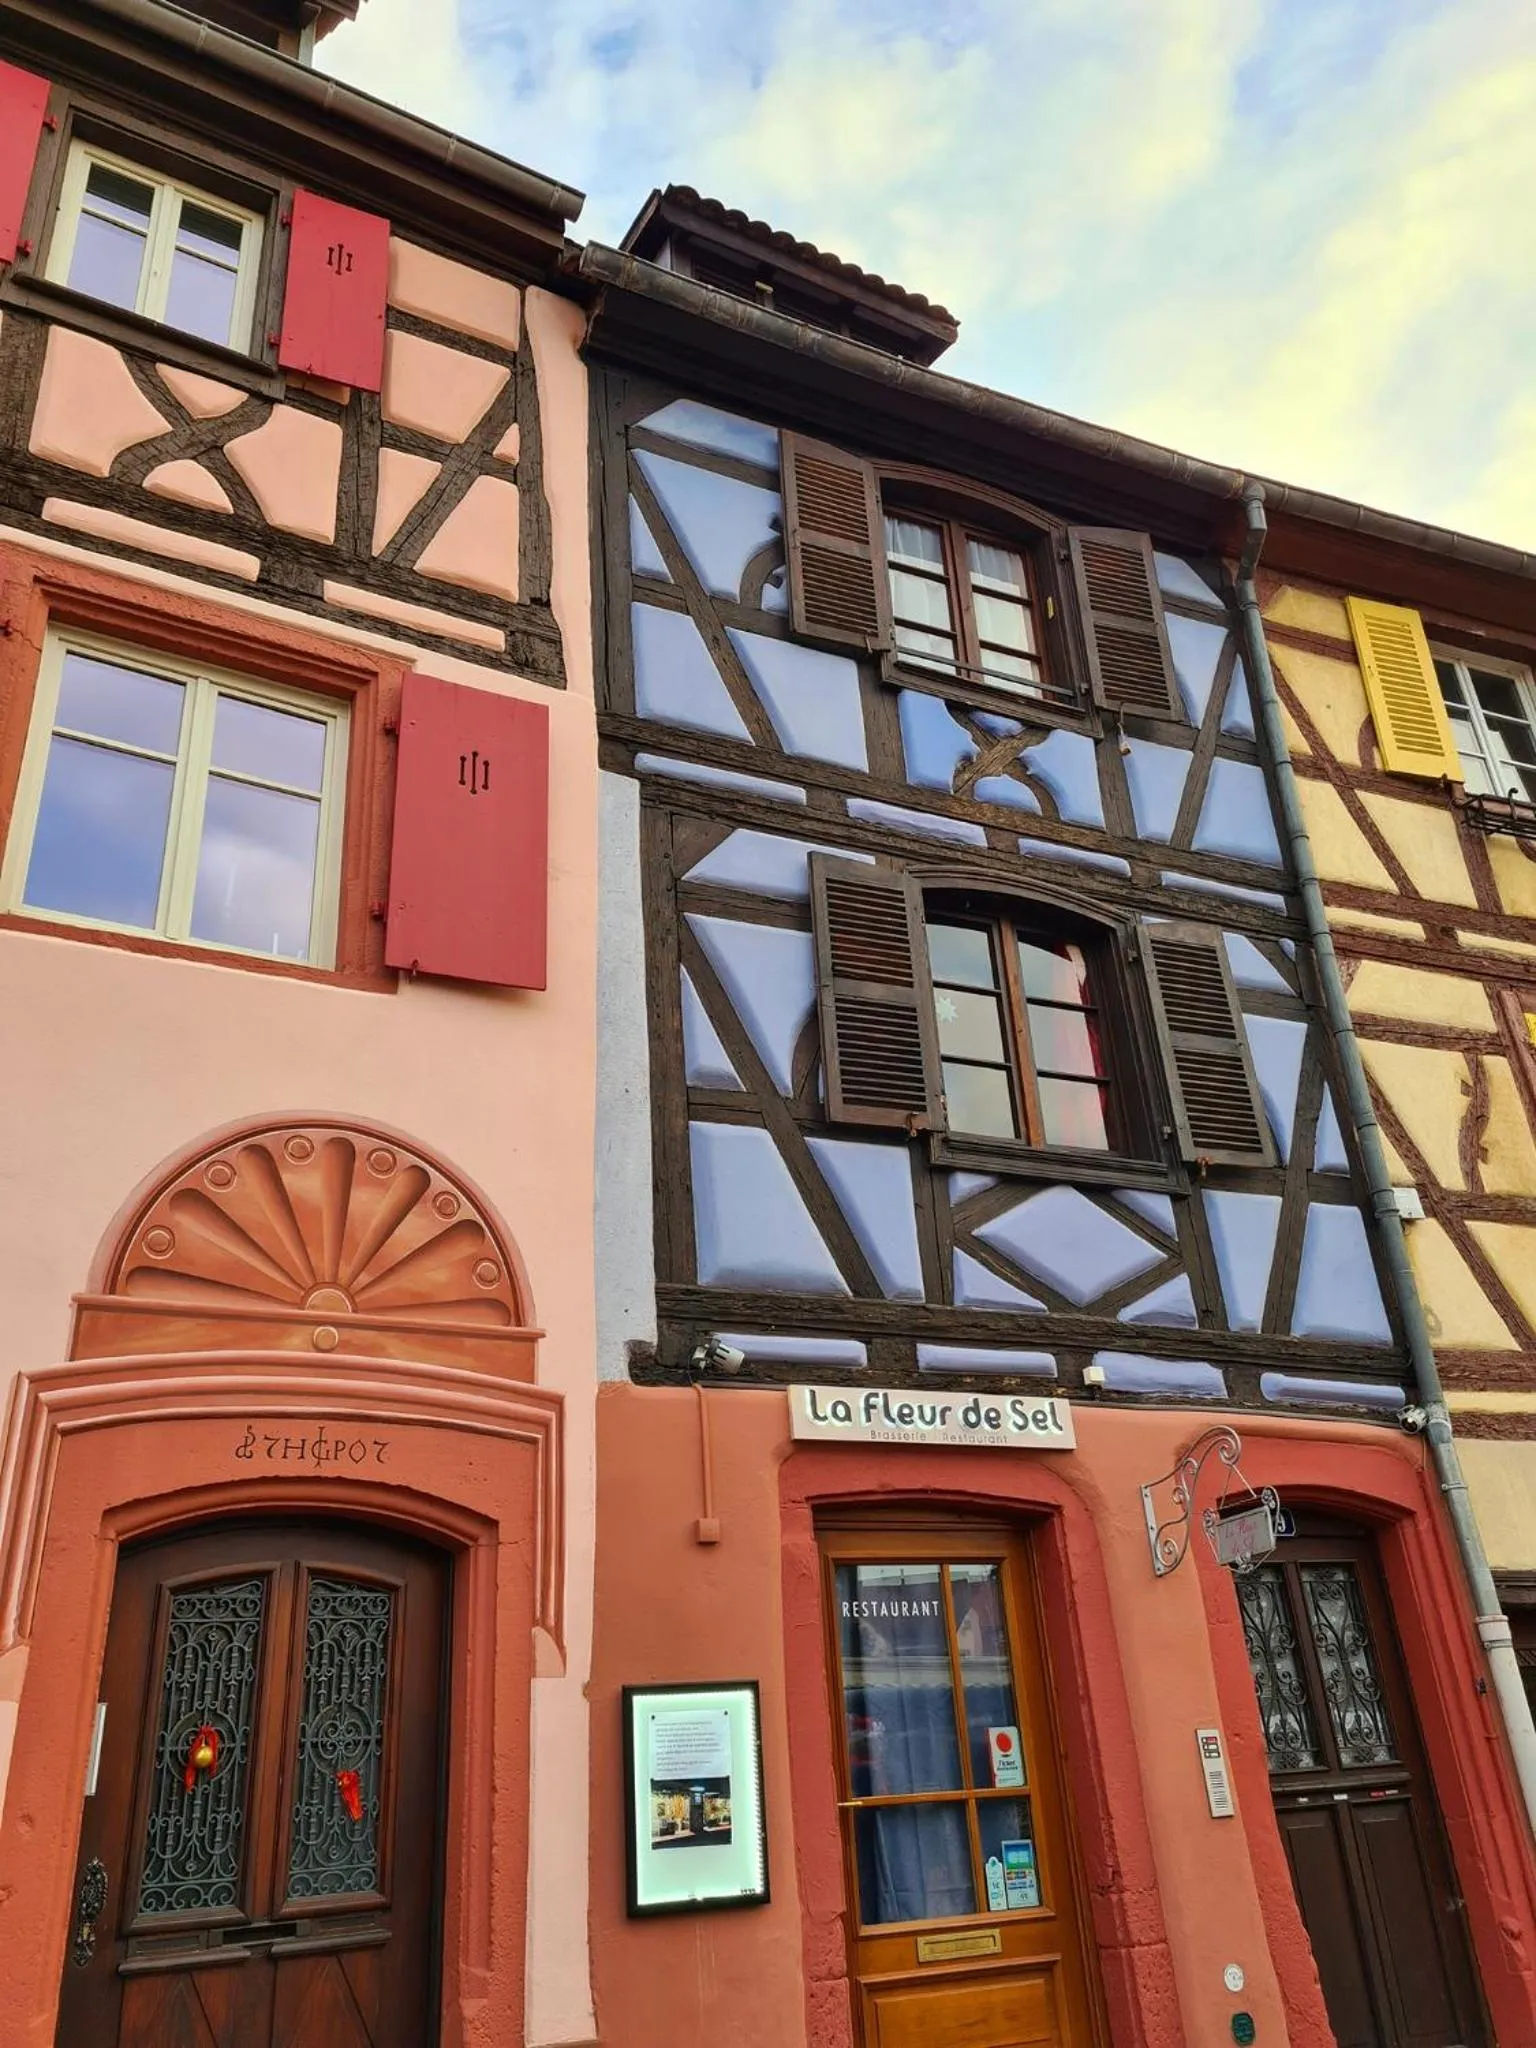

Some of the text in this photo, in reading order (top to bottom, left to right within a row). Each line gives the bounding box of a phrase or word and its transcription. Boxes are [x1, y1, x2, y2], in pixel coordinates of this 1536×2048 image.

[808, 1388, 1064, 1432] La Fleur de Sel
[870, 1430, 1008, 1444] Brasserie Restaurant
[842, 1601, 939, 1617] RESTAURANT
